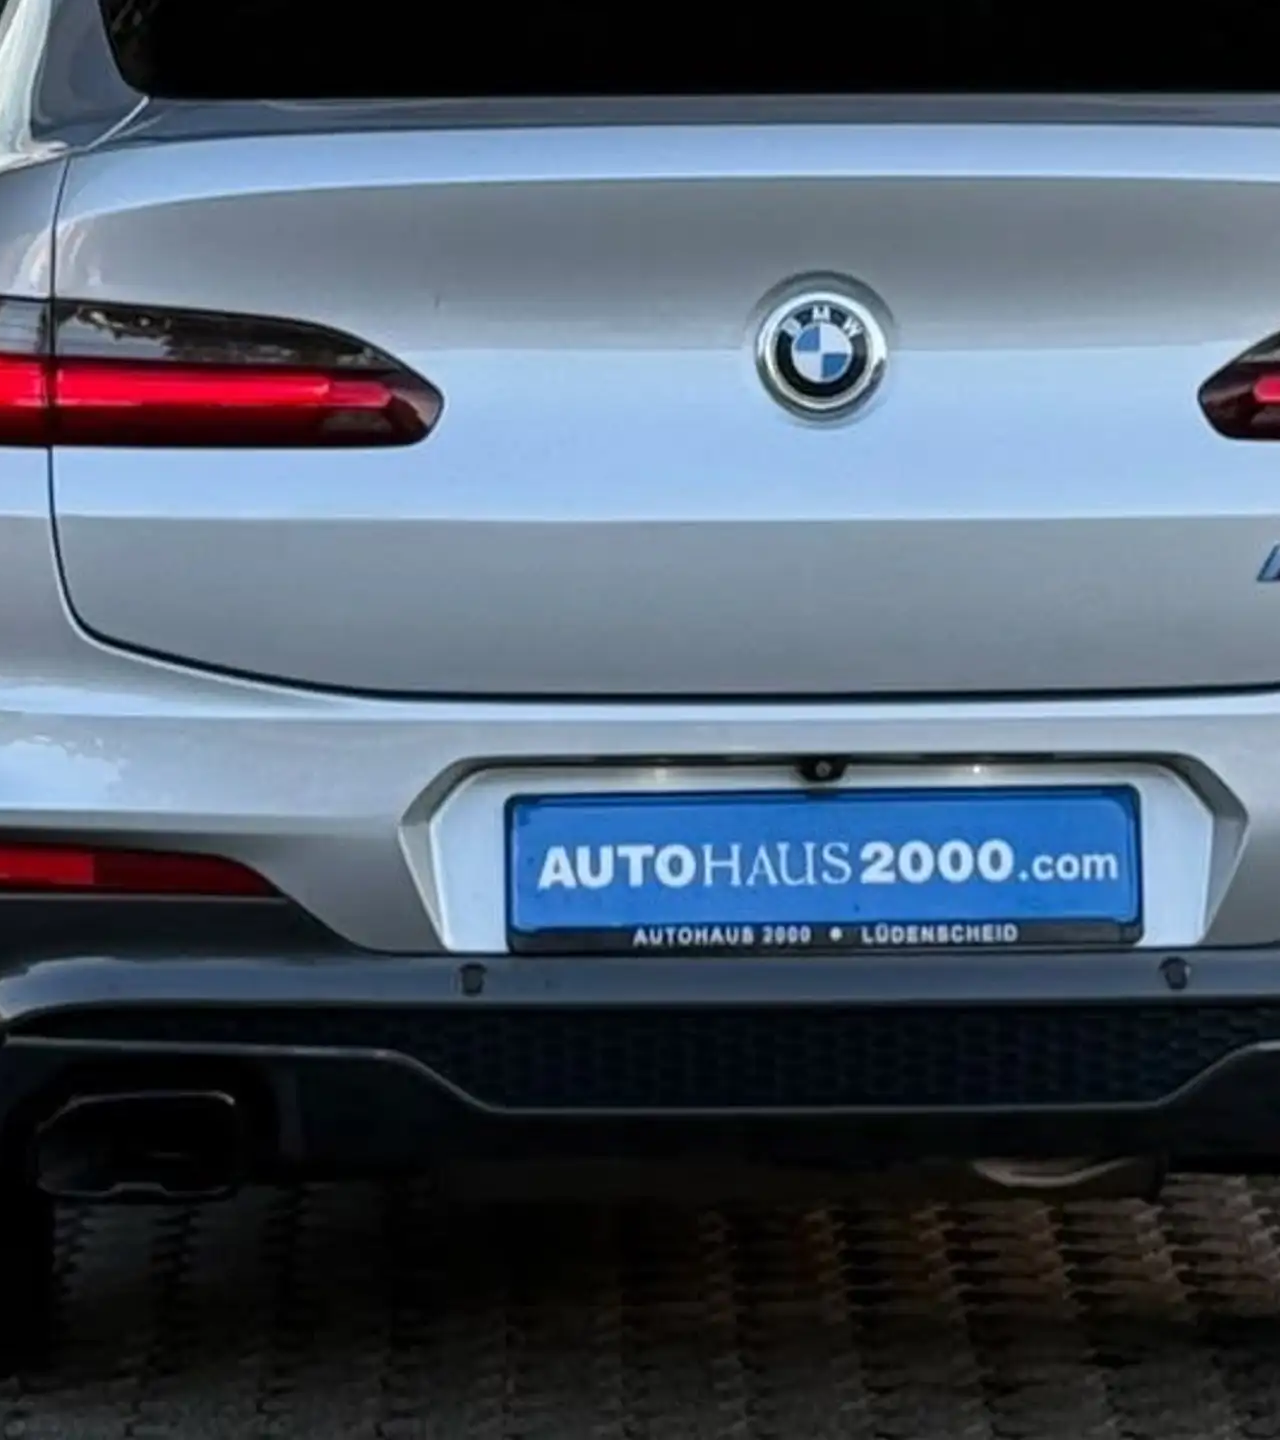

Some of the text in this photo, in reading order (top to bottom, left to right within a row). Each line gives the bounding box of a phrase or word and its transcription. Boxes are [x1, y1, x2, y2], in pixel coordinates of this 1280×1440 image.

[633, 923, 1019, 946] AUTOHAUS 2000 LÜDENSCHEID
